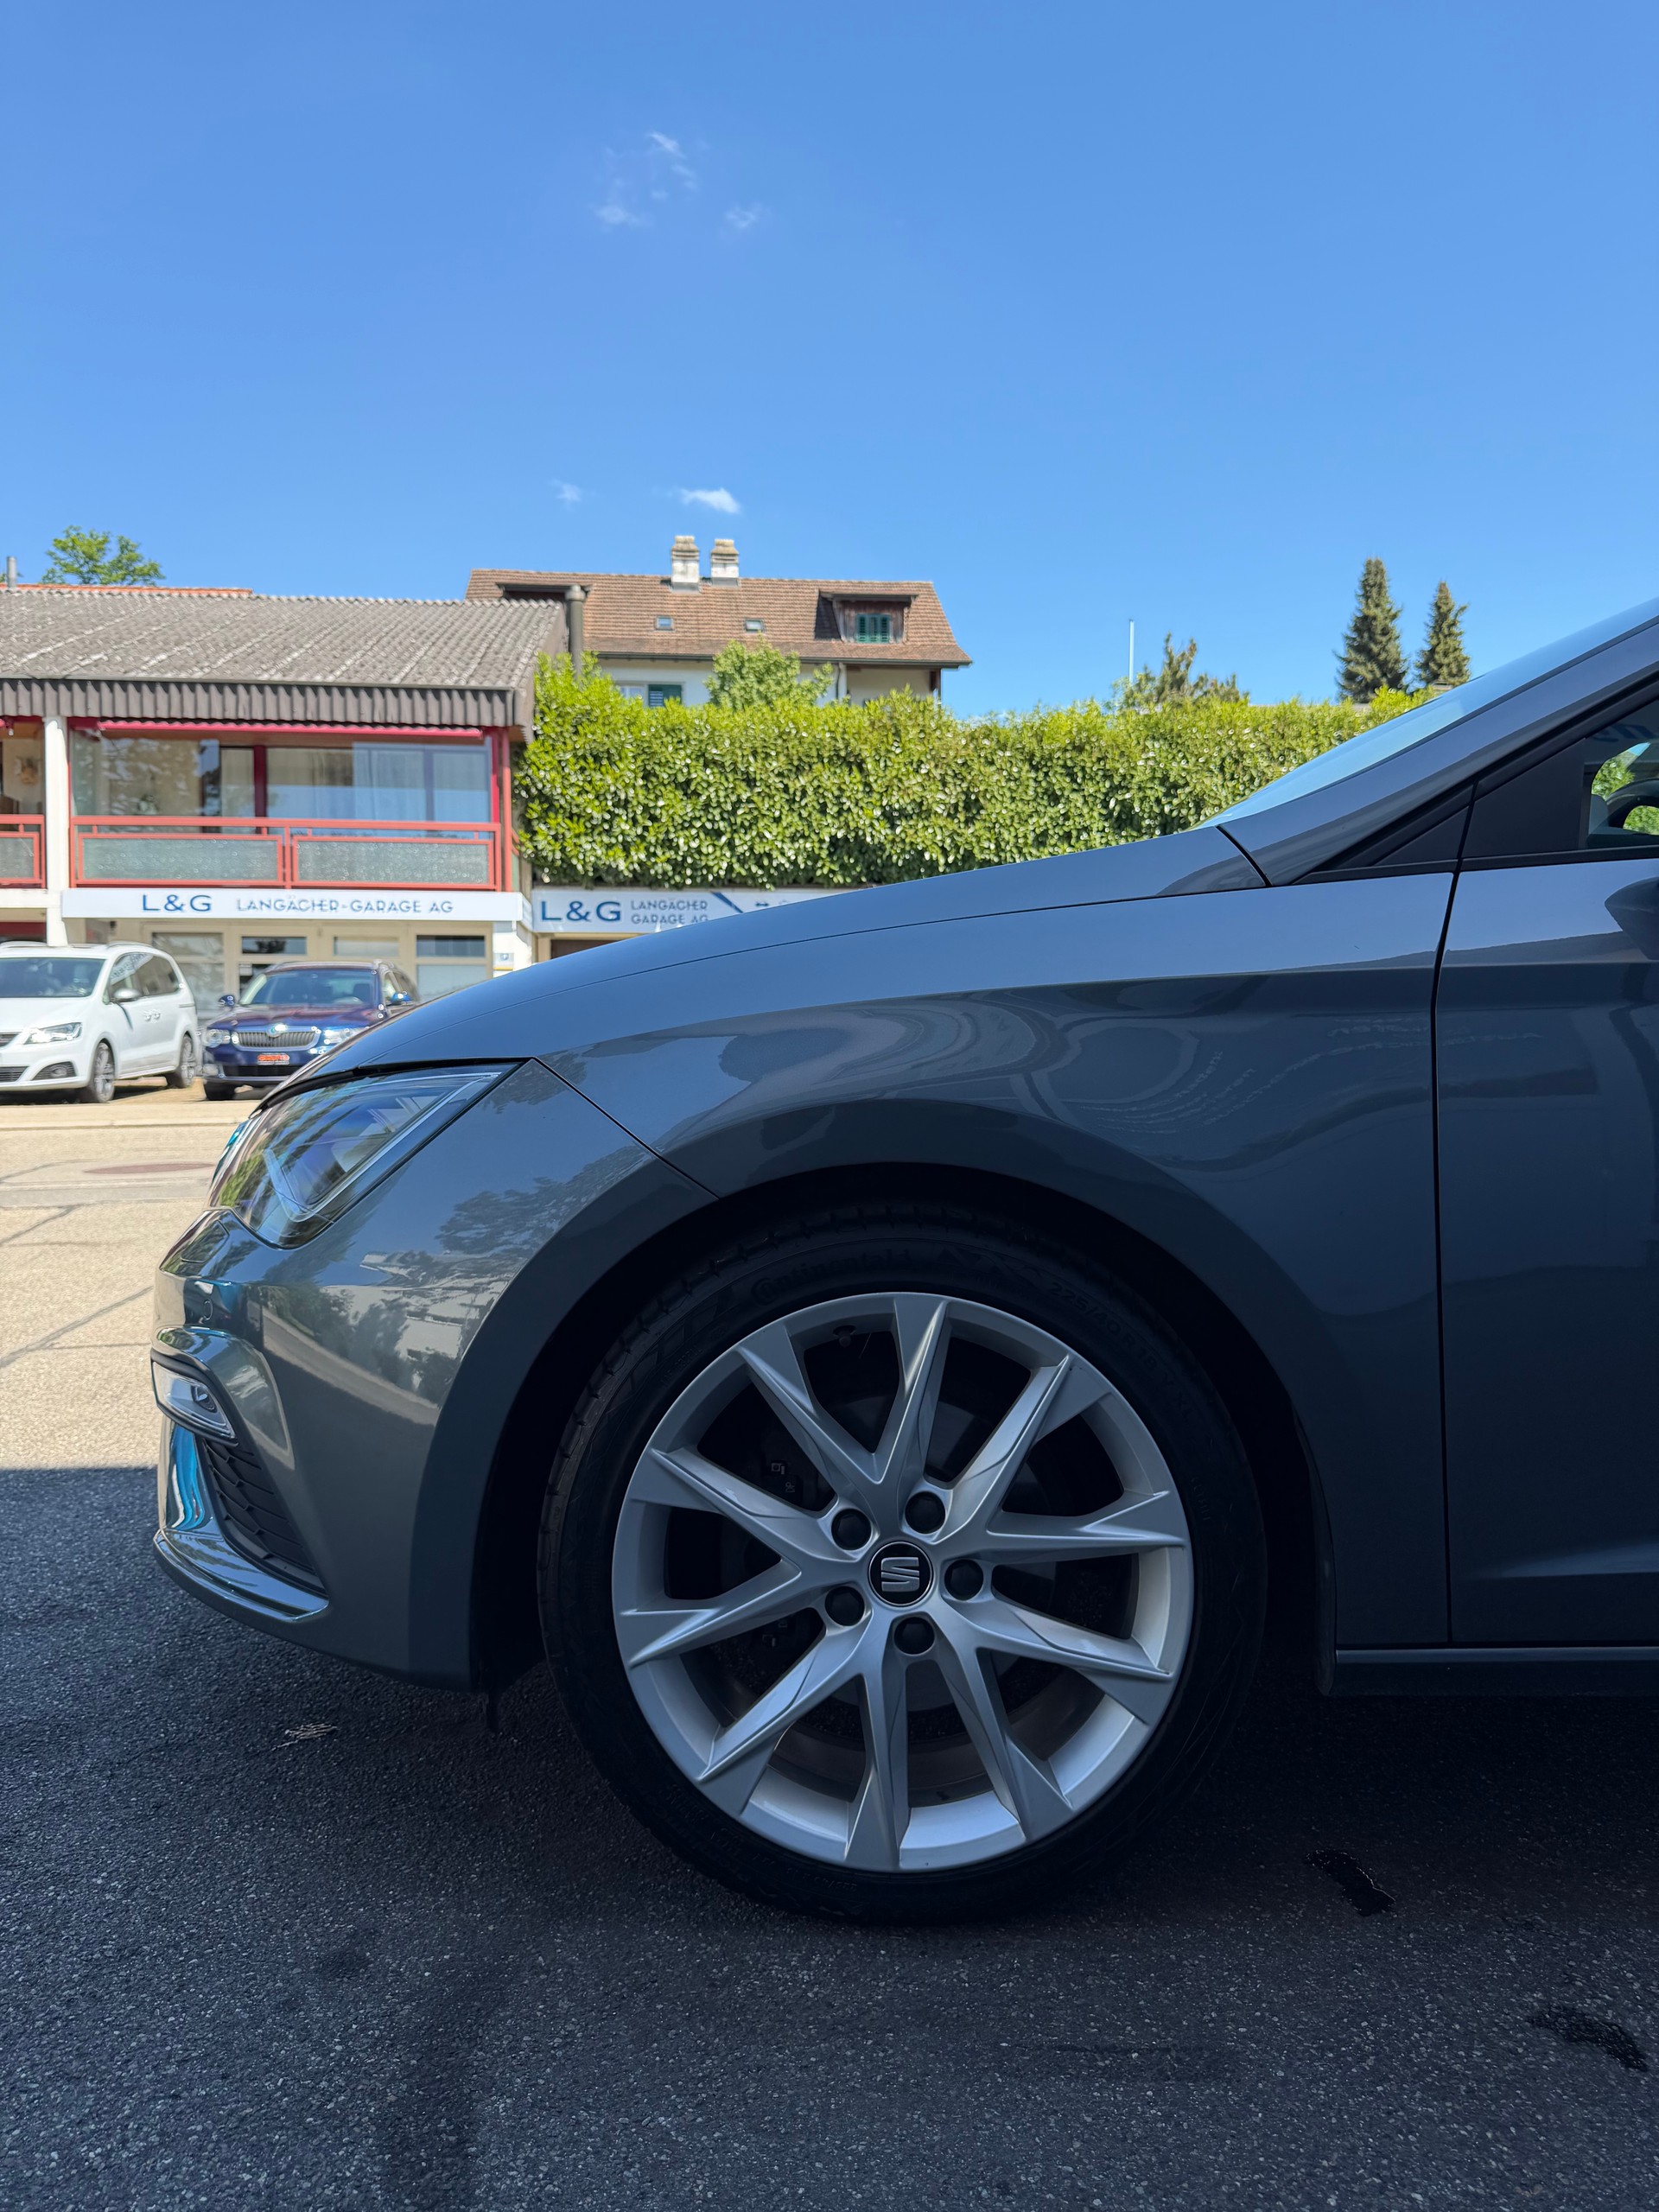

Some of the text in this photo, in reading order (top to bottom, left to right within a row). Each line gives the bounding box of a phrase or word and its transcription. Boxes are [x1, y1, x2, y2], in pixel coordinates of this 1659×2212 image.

[143, 894, 213, 912] L&G
[429, 900, 454, 913] AG
[541, 900, 622, 922] L&G
[631, 914, 709, 925] GARAGE AG
